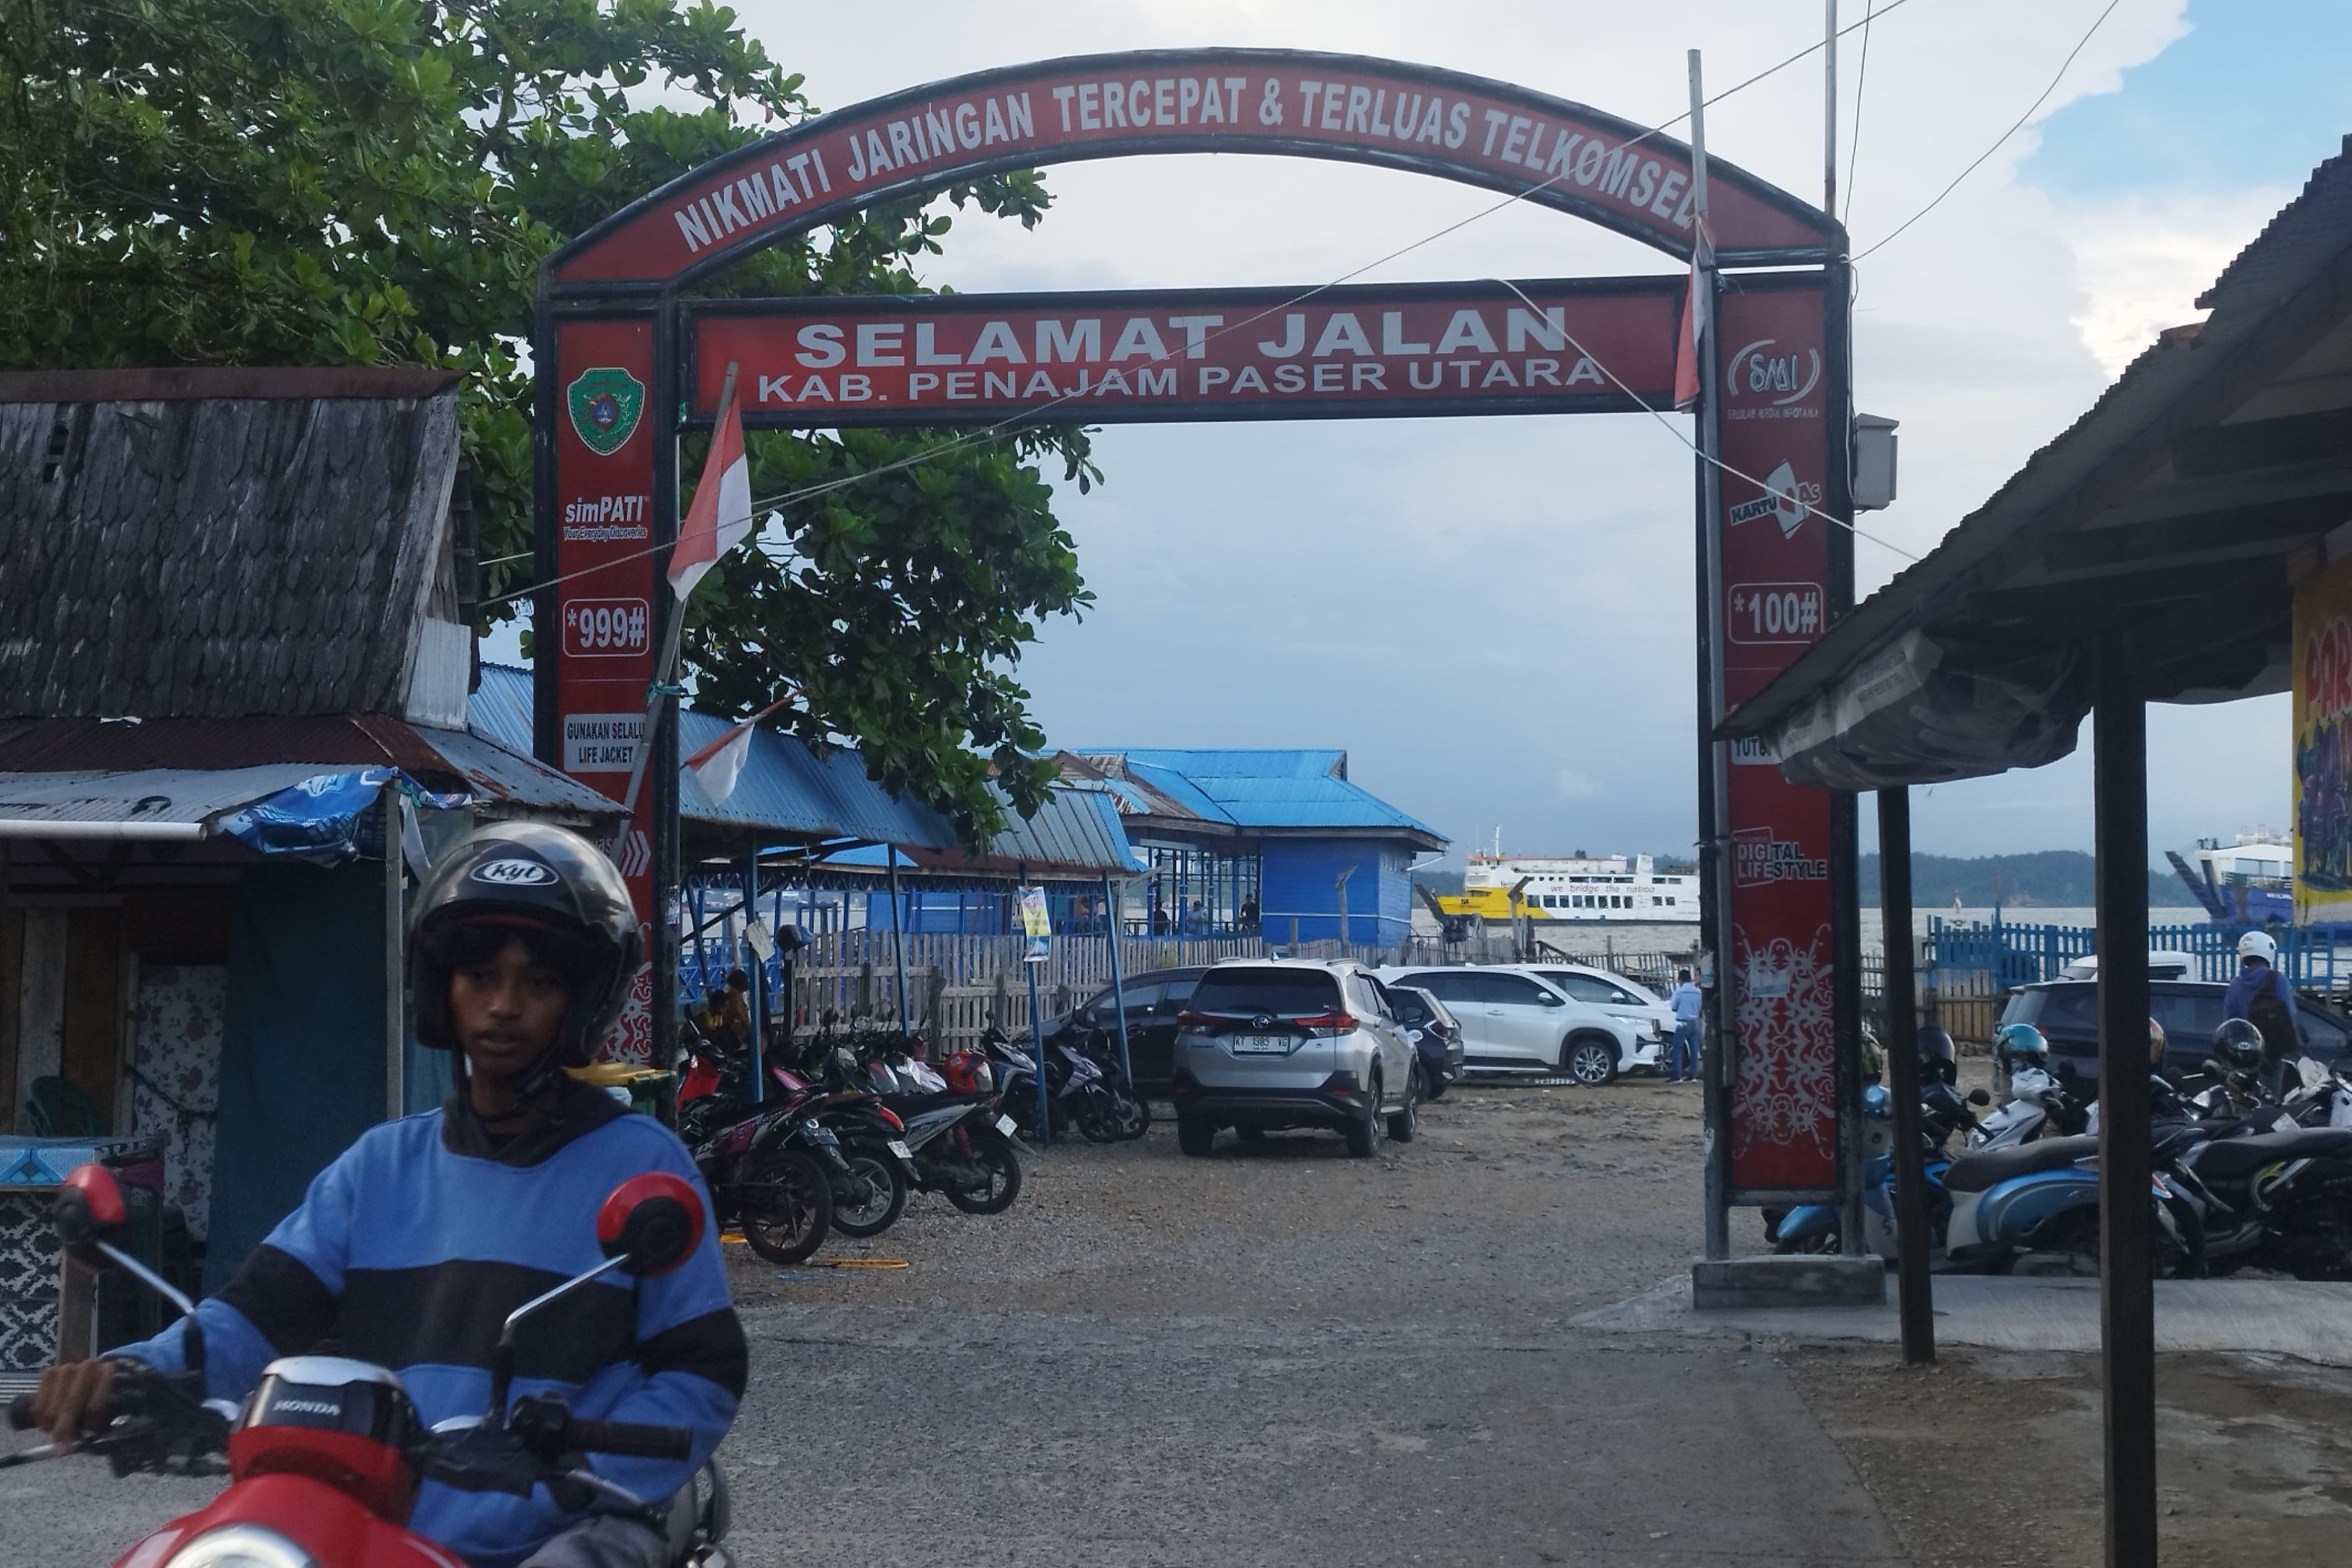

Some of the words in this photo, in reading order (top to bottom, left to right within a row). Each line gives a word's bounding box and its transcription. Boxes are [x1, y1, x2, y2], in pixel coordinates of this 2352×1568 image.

[675, 149, 832, 253] NIKMATI
[847, 92, 1034, 182] JARINGAN
[1053, 77, 1246, 132] TERCEPAT
[1259, 78, 1283, 125] &
[1300, 81, 1470, 149] TERLUAS
[794, 315, 1224, 369] SELAMAT
[1258, 307, 1565, 358] JALAN
[758, 374, 887, 403] KAB.
[909, 367, 1177, 401] PENAJAM
[1199, 361, 1388, 395] PASER
[1410, 357, 1605, 390] UTARA
[565, 496, 643, 522] simPATI
[1731, 496, 1777, 524] KARTU
[567, 722, 609, 740] GUNAKAN
[612, 722, 645, 740] SELALU
[578, 746, 598, 764] LIFE
[599, 746, 634, 764] JACKET
[1738, 843, 1805, 861] DIGITAL
[1738, 860, 1827, 879] LIFESTYLE
[1569, 884, 1599, 894] bridge
[273, 1400, 341, 1416] HONDA
